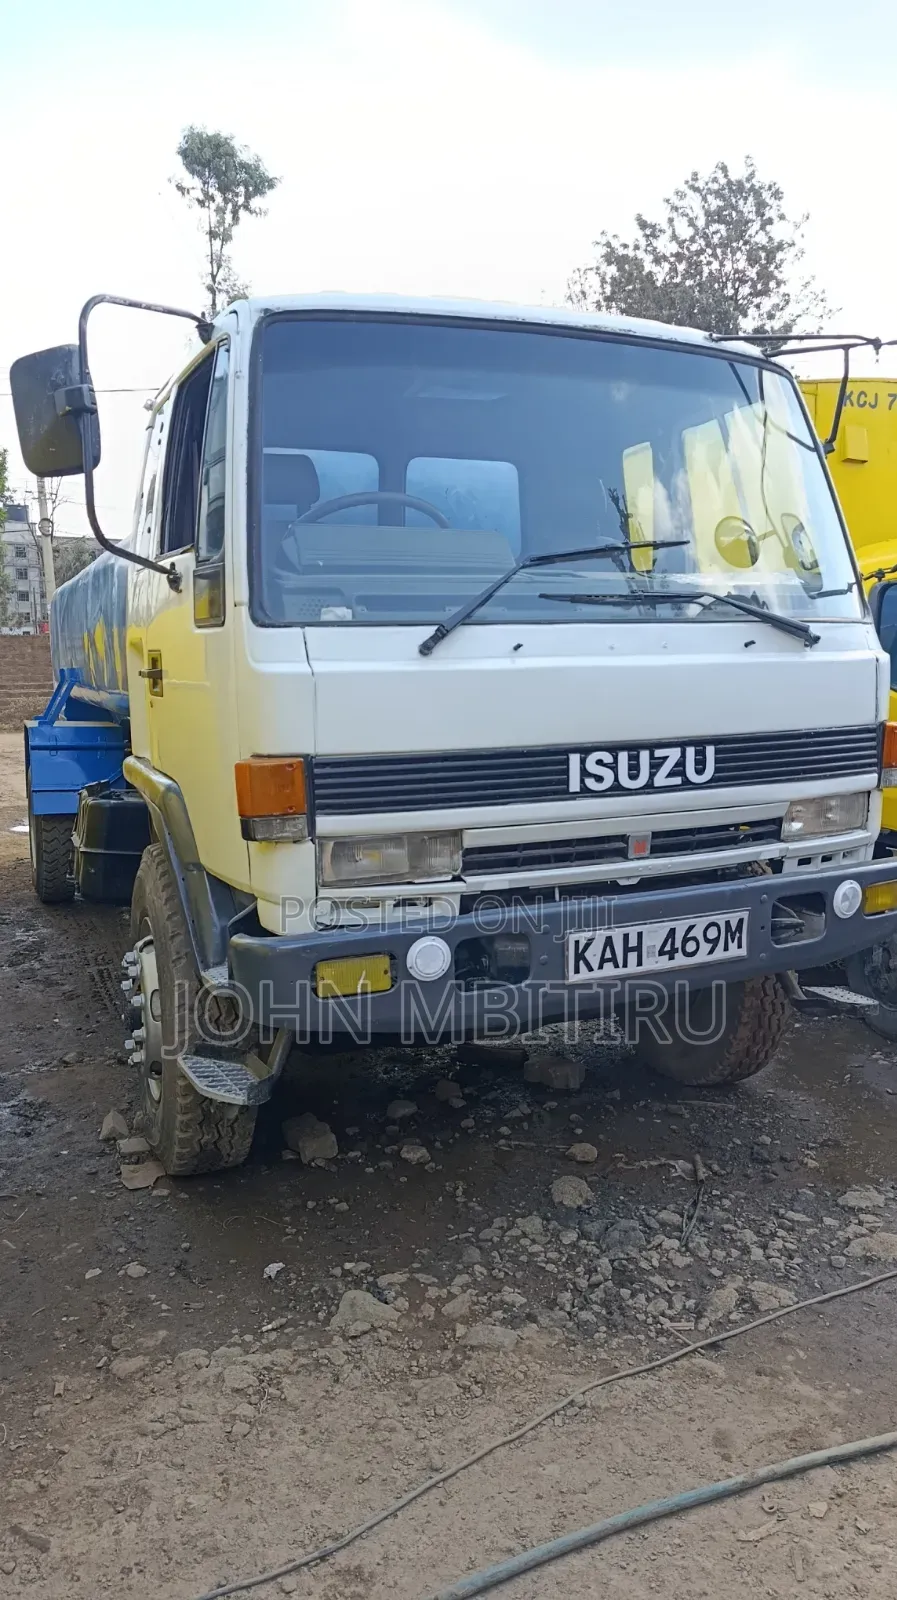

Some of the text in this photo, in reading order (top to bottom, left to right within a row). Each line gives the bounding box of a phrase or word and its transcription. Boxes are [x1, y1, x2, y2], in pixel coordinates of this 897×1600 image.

[843, 390, 878, 409] KCJ
[568, 745, 715, 793] ISUZU
[573, 917, 745, 975] KAH 469M
